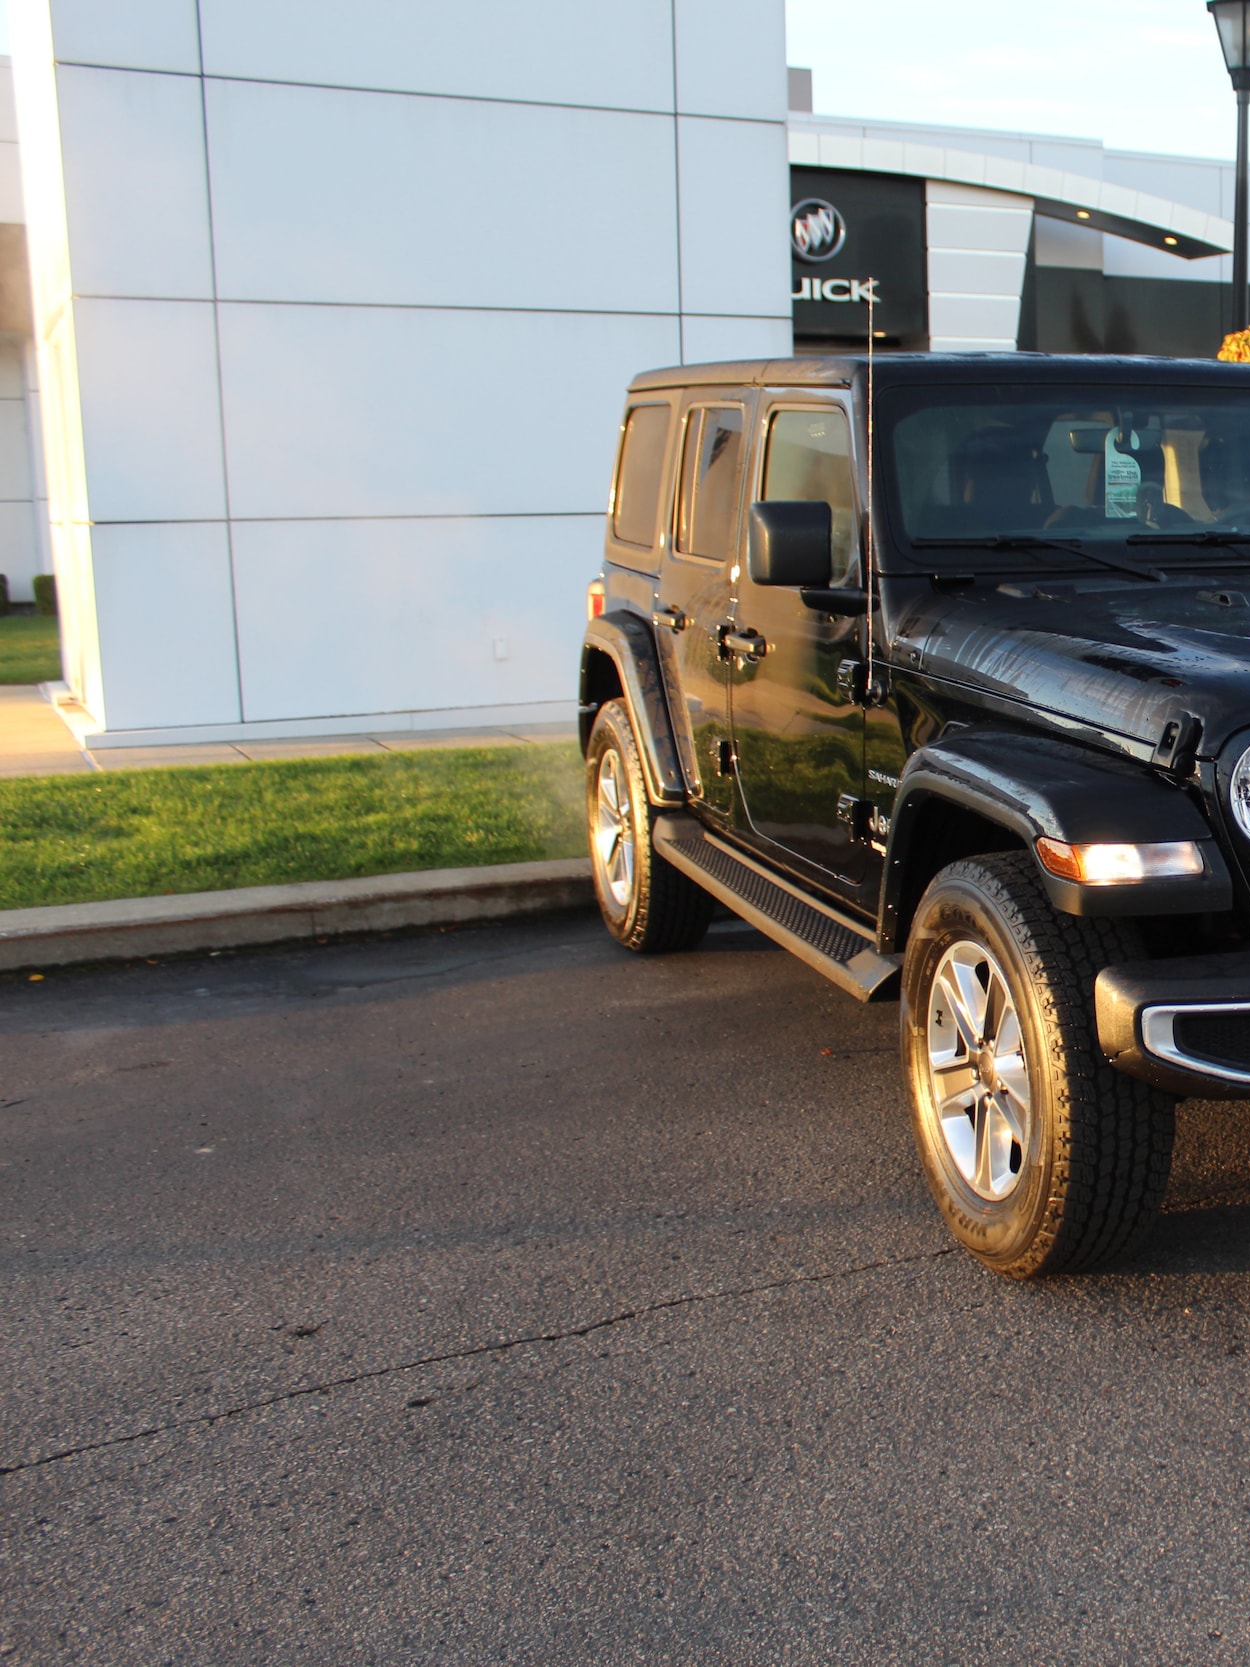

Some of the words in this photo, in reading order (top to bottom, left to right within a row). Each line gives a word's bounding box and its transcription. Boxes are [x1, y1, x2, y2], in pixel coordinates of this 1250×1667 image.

[791, 277, 882, 302] UICK
[868, 769, 900, 788] SAHAR
[869, 806, 891, 836] Je
